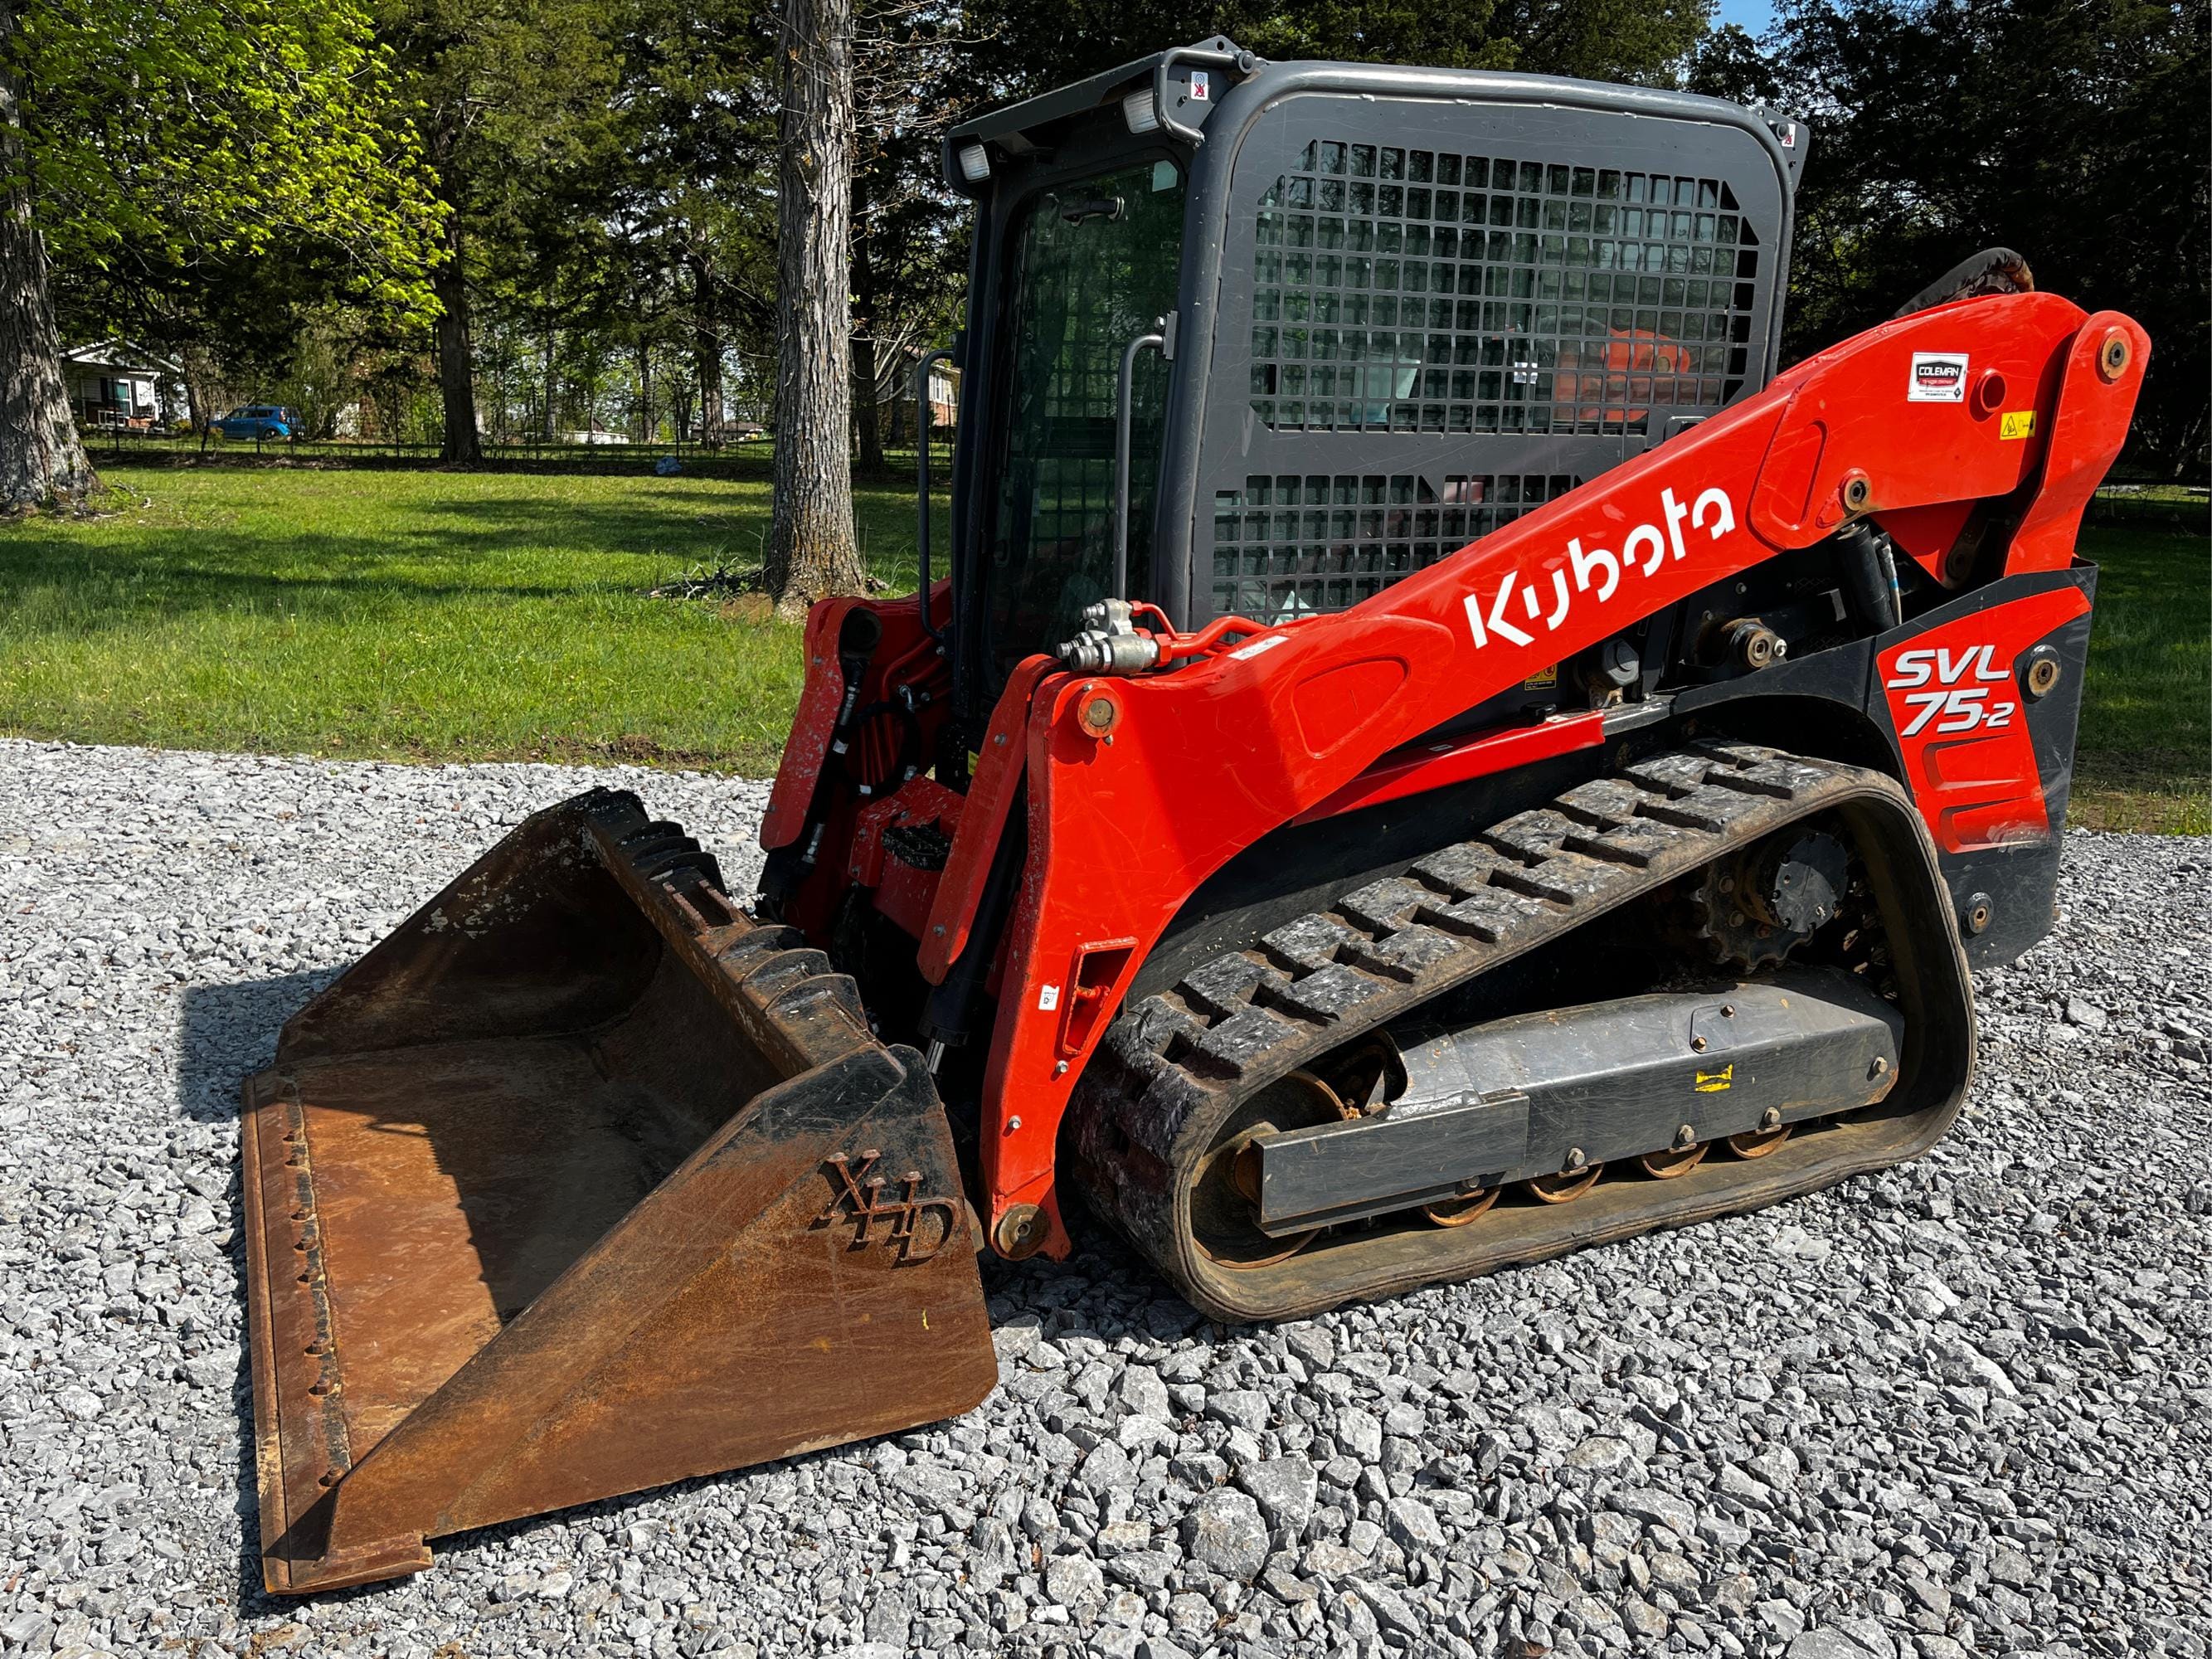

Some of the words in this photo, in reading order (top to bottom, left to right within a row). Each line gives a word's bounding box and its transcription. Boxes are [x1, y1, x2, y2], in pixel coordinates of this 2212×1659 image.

[1918, 366, 1959, 377] COLEMAN
[1463, 487, 1736, 649] Kubota
[1887, 645, 2011, 689] SVL
[1900, 688, 2015, 737] 75-2
[818, 1149, 961, 1262] XHD
